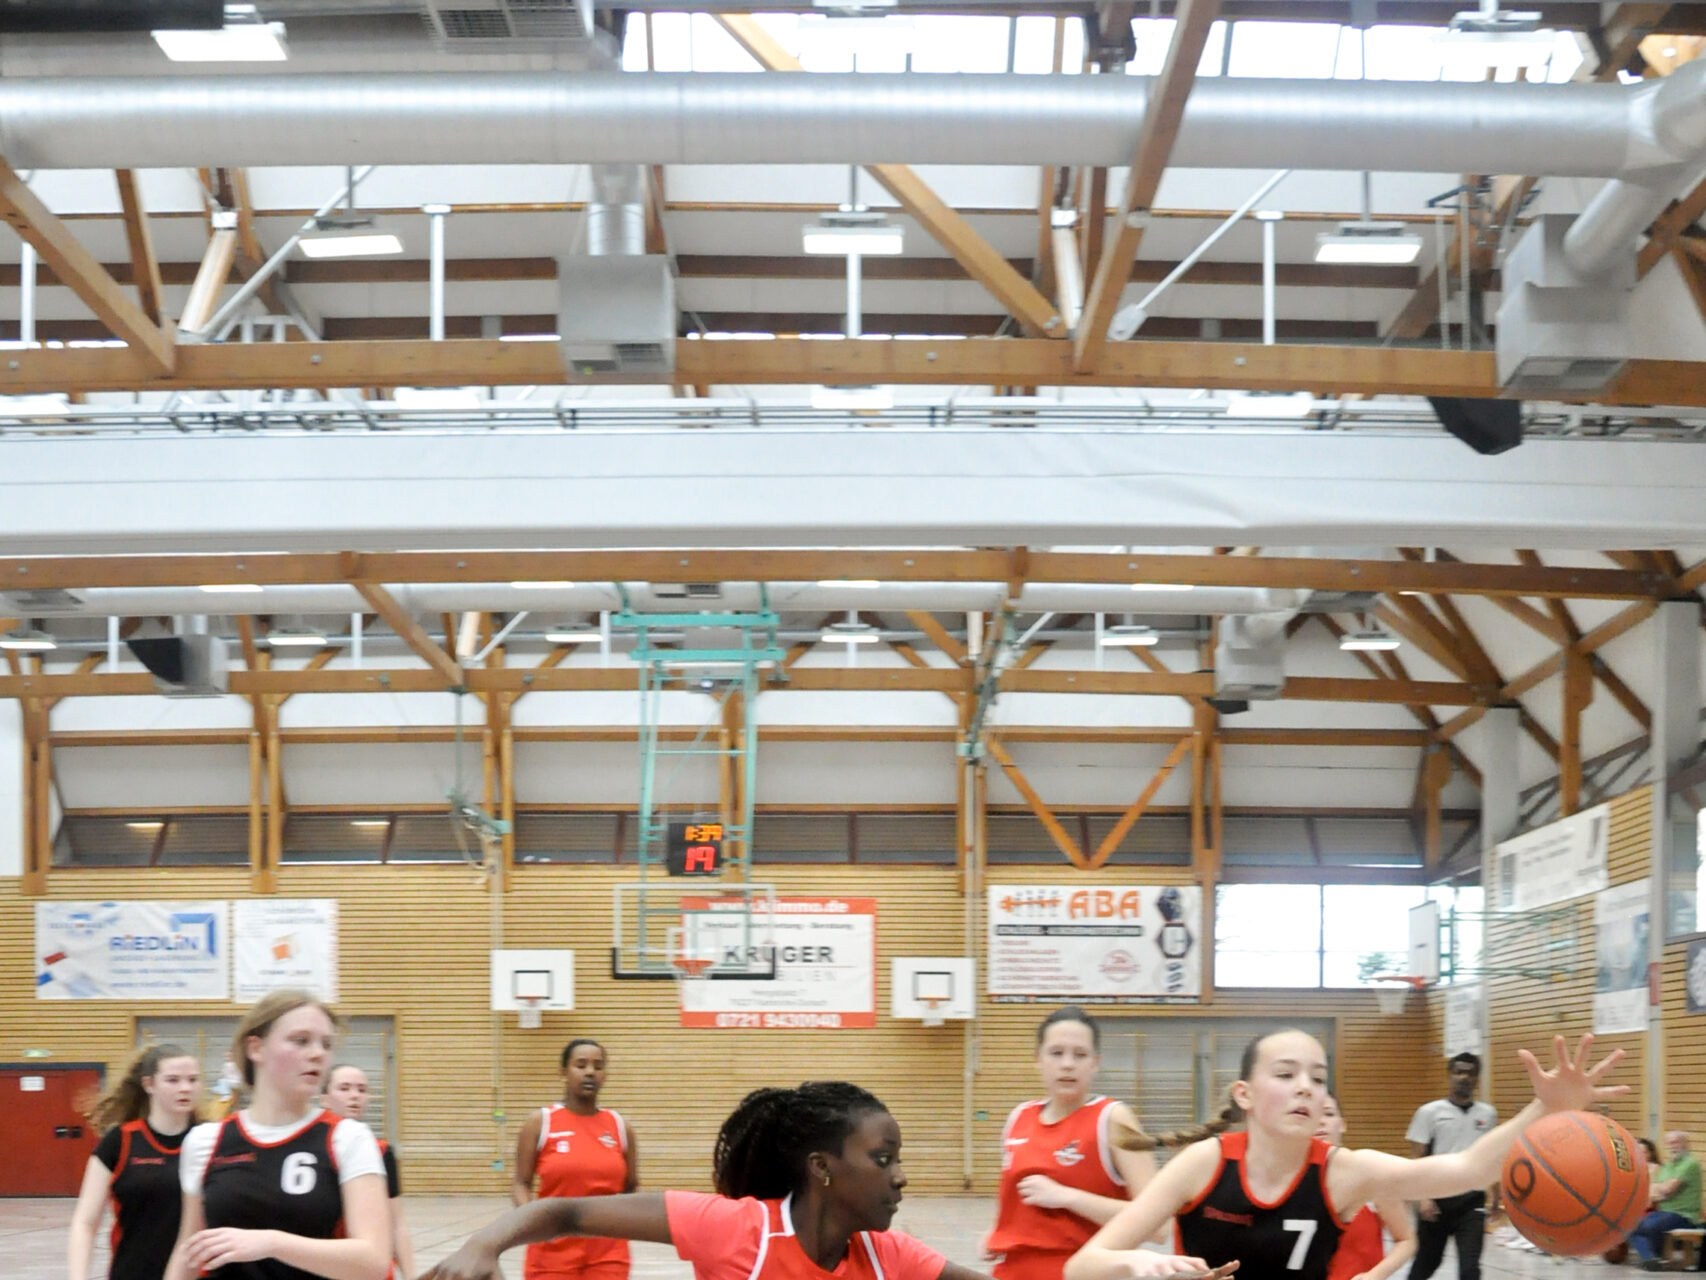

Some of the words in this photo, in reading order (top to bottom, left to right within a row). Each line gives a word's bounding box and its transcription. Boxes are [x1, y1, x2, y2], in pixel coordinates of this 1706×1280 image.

[1068, 890, 1141, 919] ABA
[281, 1151, 318, 1195] 6
[1282, 1219, 1318, 1270] 7
